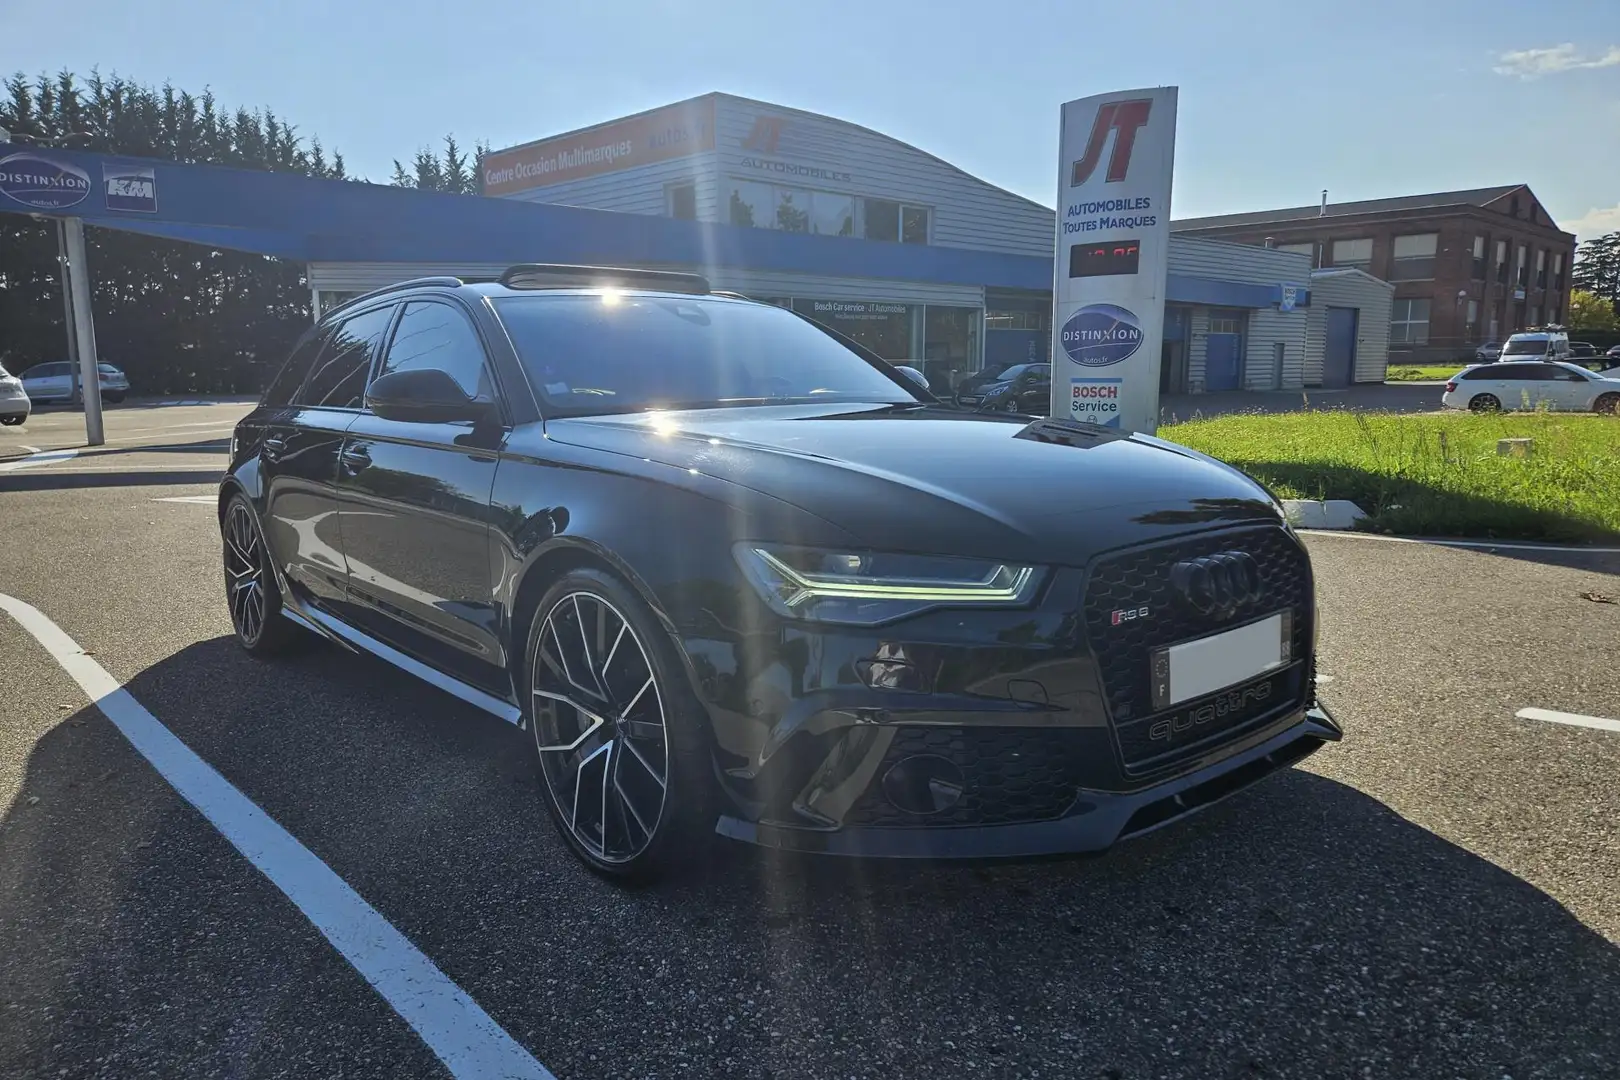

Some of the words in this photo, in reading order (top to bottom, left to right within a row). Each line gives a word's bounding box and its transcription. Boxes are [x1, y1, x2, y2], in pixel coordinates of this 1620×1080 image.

[1071, 98, 1153, 188] JT
[485, 167, 514, 185] Centre
[515, 156, 556, 179] Occasion
[558, 140, 632, 170] Multimarques
[740, 156, 852, 182] AUTOMOBILES
[0, 172, 87, 188] DISTINXION
[1067, 197, 1151, 217] AUTOMOBILES
[814, 302, 832, 312] Bosch
[833, 302, 844, 312] Car
[1063, 329, 1138, 341] DISTINXION
[1072, 386, 1118, 399] BOSCH
[1072, 400, 1117, 412] Service
[1149, 681, 1272, 742] quattro
